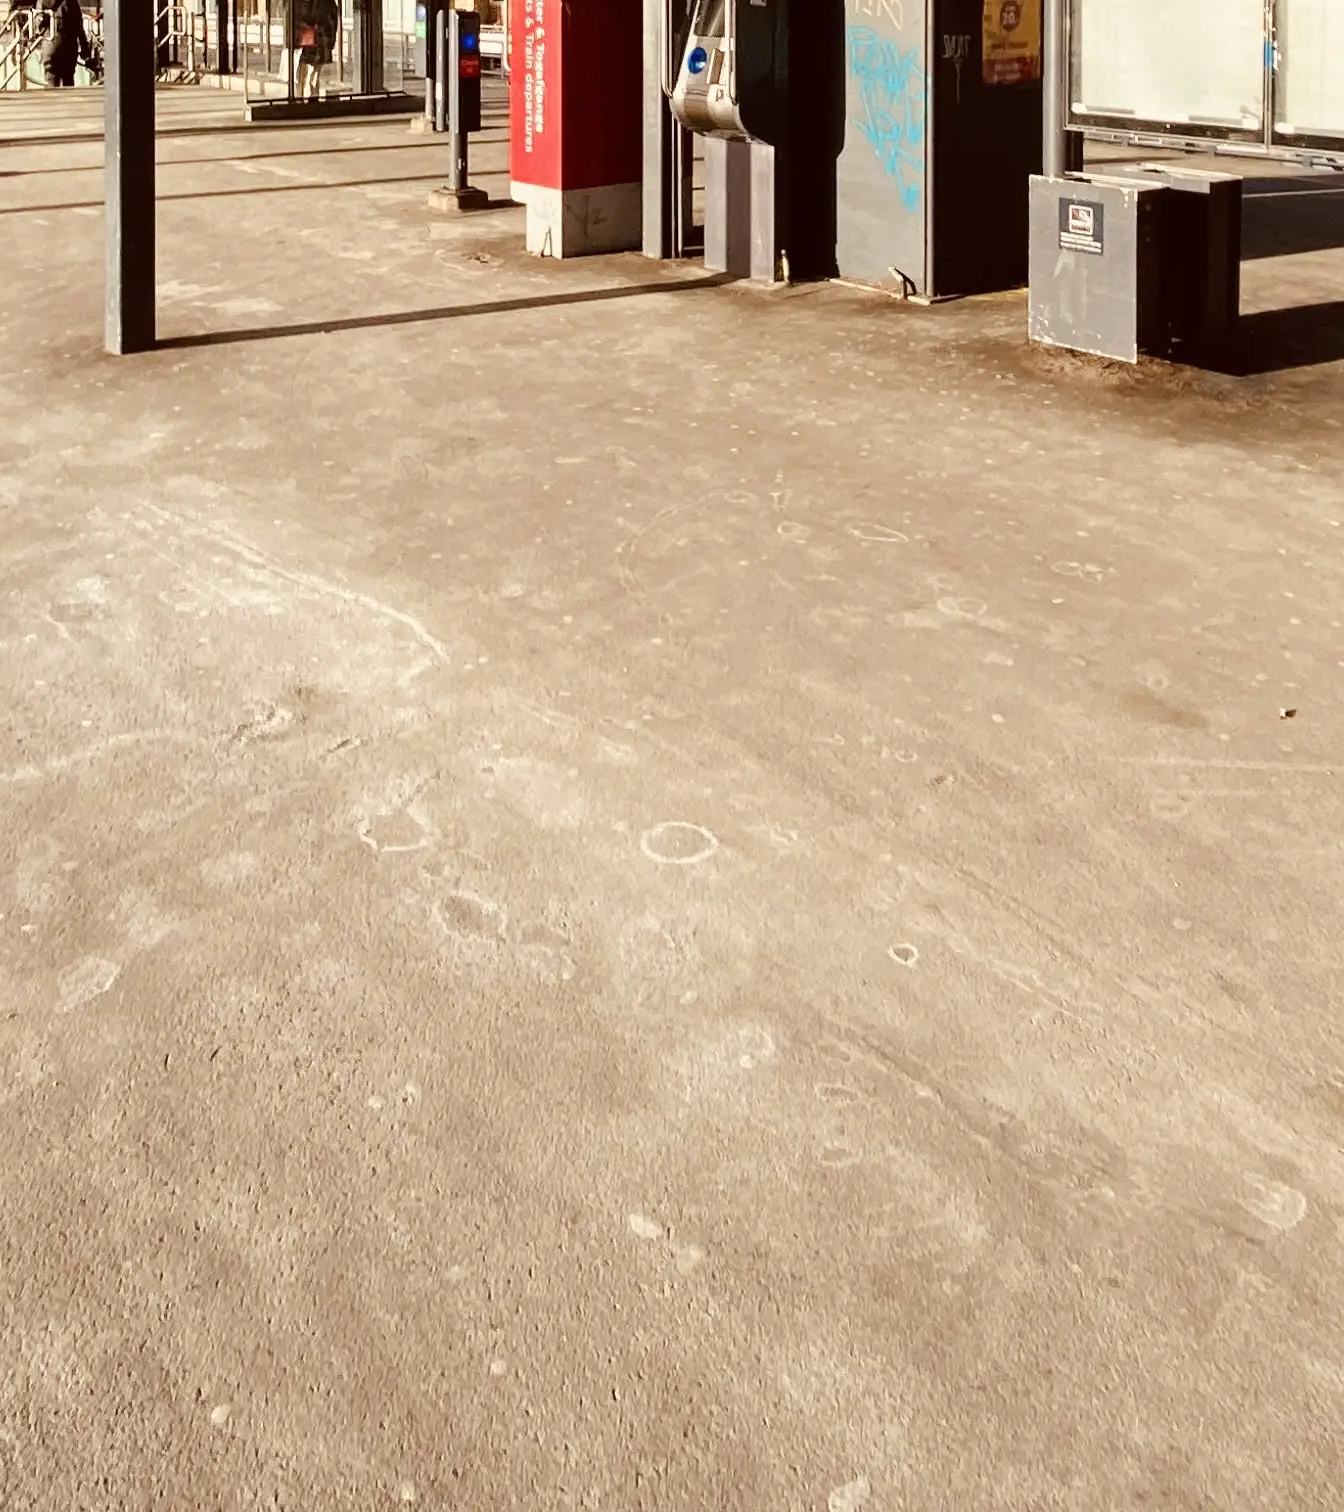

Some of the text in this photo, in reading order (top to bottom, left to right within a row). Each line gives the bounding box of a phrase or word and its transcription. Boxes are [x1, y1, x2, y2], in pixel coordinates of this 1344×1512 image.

[524, 17, 535, 29] &
[535, 27, 545, 39] &
[525, 32, 535, 69] Train
[524, 73, 534, 153] departures
